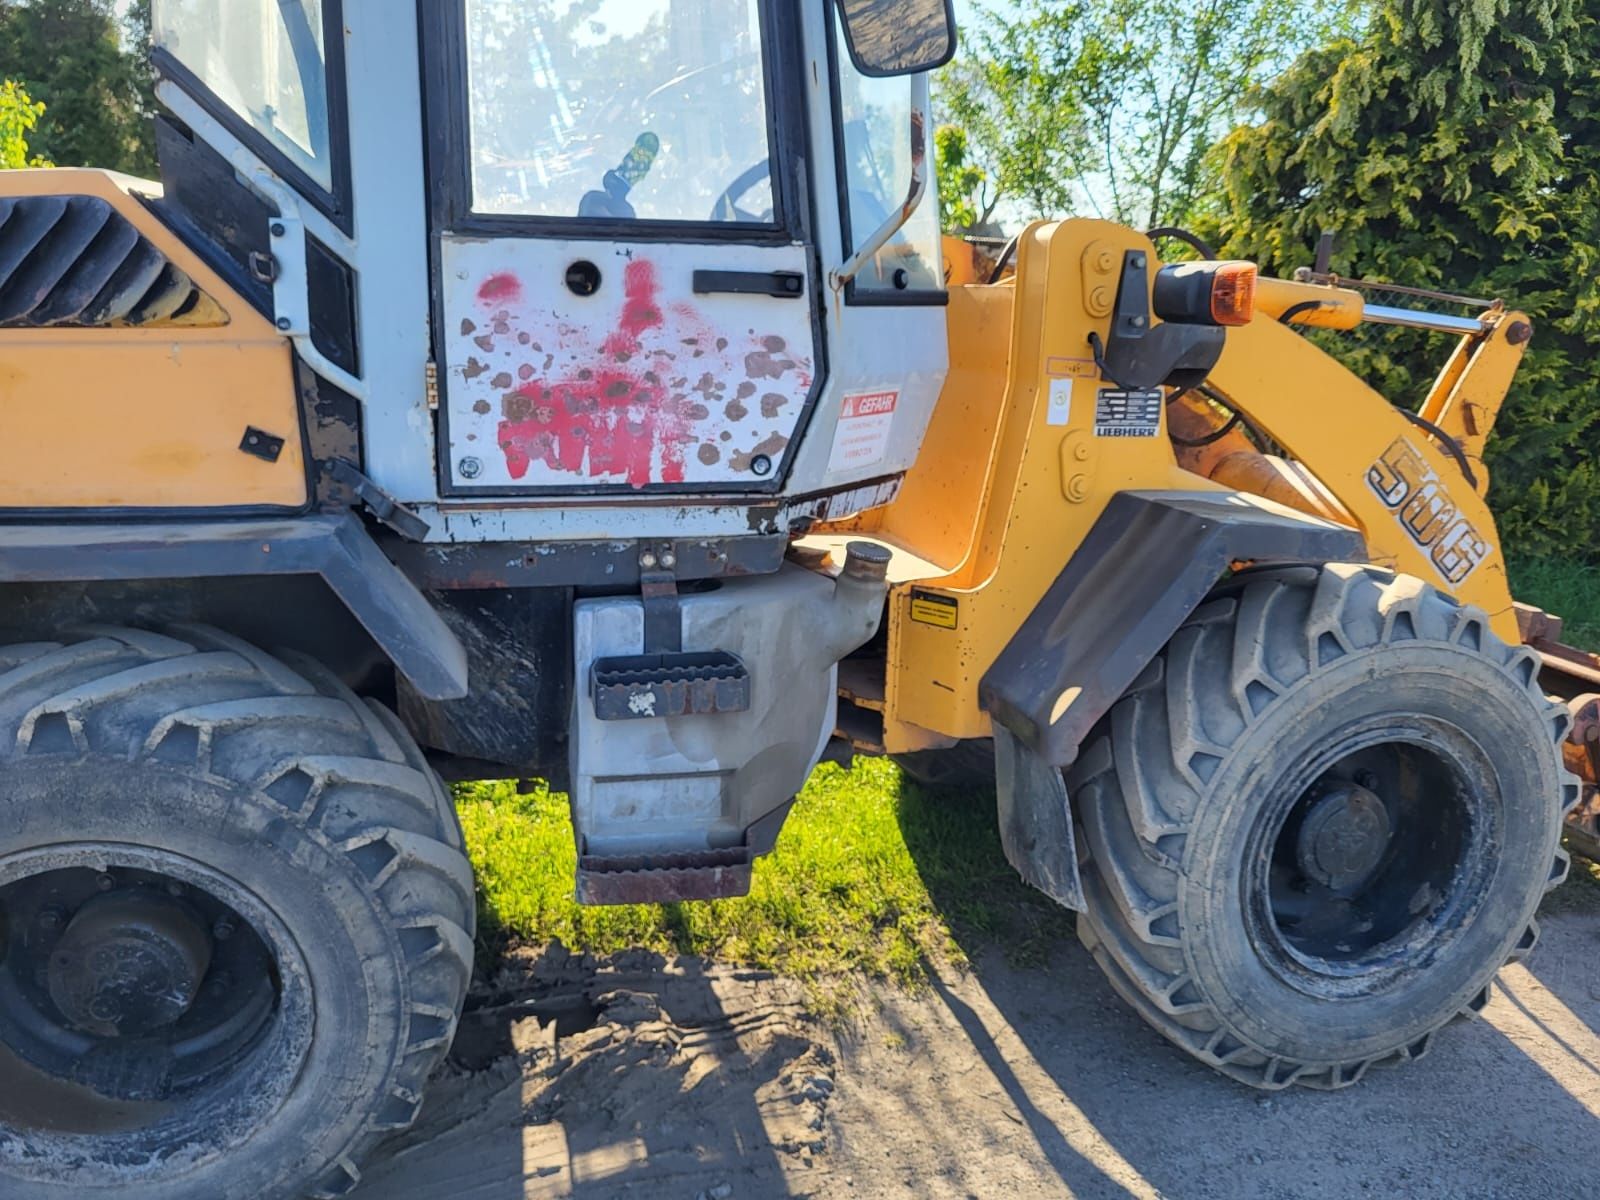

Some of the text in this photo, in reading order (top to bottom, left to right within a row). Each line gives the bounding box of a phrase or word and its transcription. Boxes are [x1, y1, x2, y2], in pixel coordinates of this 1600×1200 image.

[859, 395, 893, 413] GEFAHR
[1097, 427, 1156, 437] LIEBHERR
[1367, 436, 1488, 585] 506
